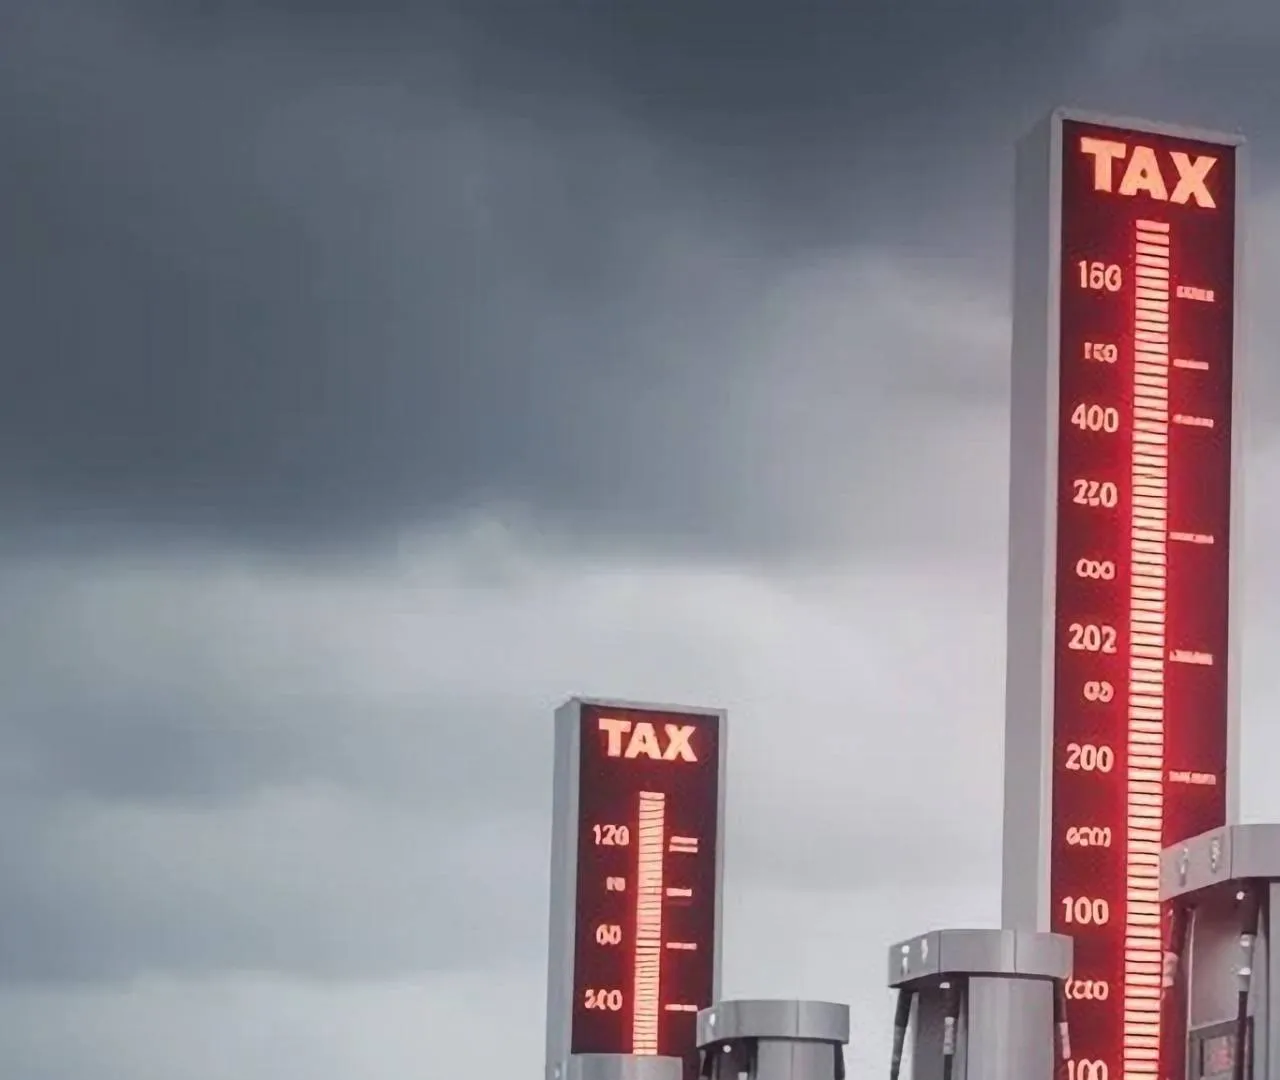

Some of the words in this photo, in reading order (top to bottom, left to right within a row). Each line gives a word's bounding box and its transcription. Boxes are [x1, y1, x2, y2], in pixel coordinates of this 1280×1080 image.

[1080, 136, 1217, 208] TAX
[1071, 403, 1119, 432] 400
[1068, 623, 1117, 654] 202
[599, 718, 697, 762] TAX
[1065, 742, 1114, 773] 200
[1062, 896, 1109, 925] 100
